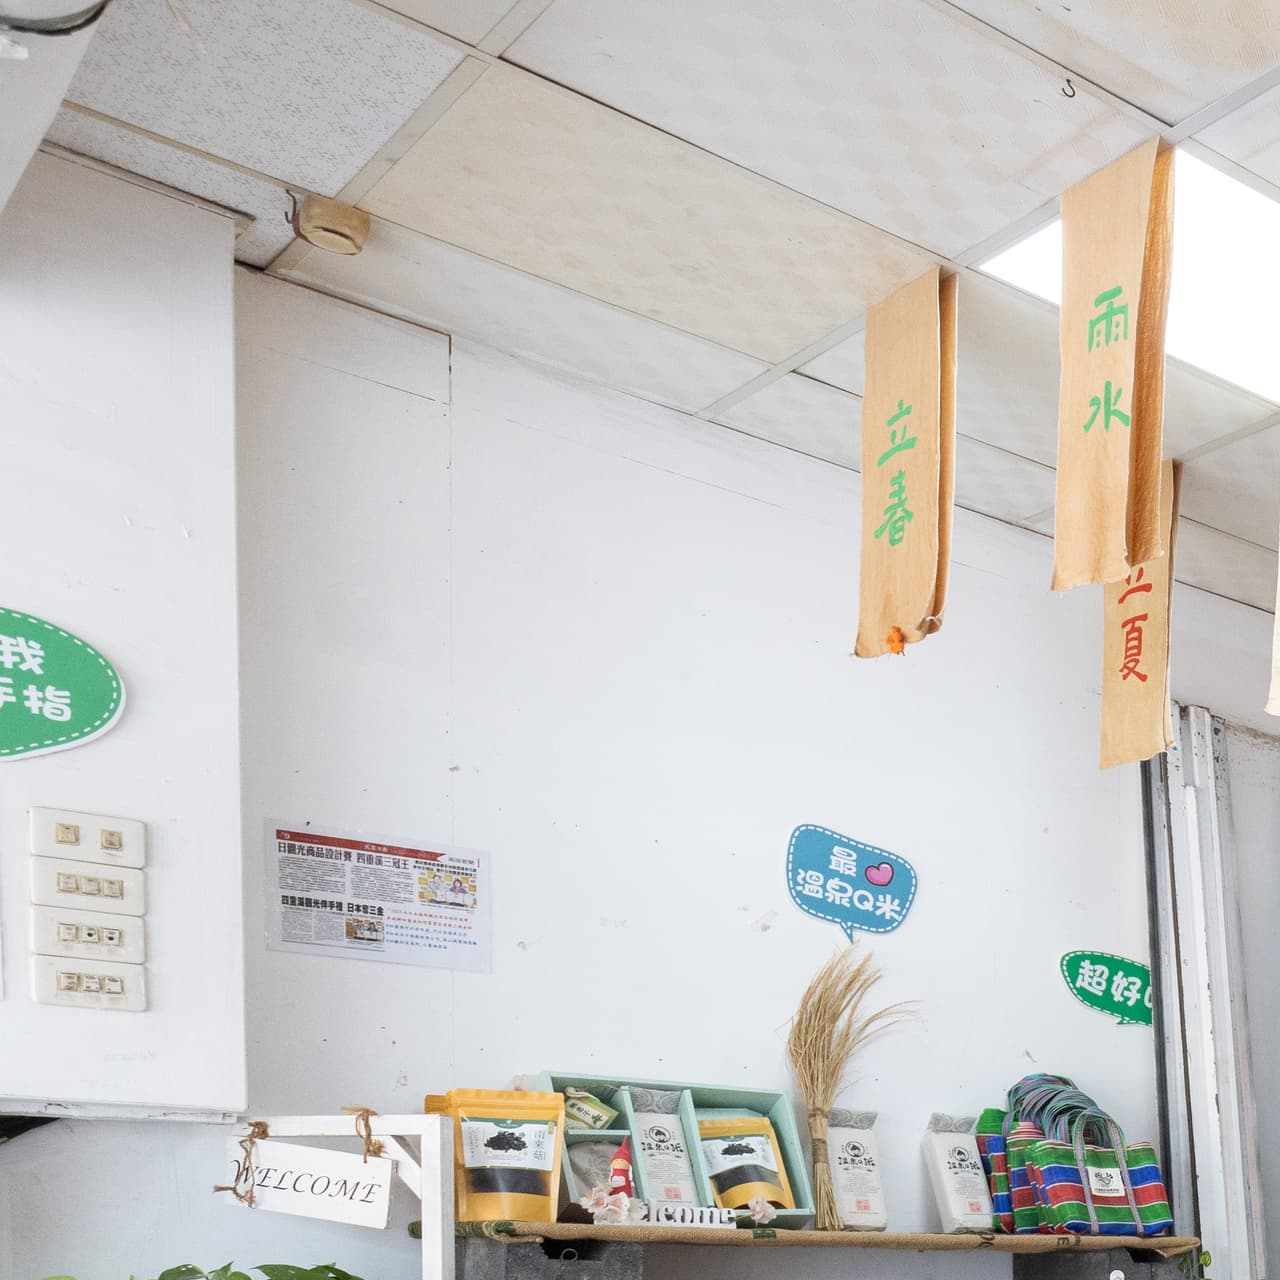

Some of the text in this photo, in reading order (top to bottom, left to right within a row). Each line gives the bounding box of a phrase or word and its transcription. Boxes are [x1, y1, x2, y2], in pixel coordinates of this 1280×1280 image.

[1083, 285, 1132, 433] 雨水
[874, 400, 918, 547] 立春
[829, 845, 858, 878] 最
[796, 868, 902, 923] 溫泉Q米
[231, 1159, 383, 1204] WELCOME
